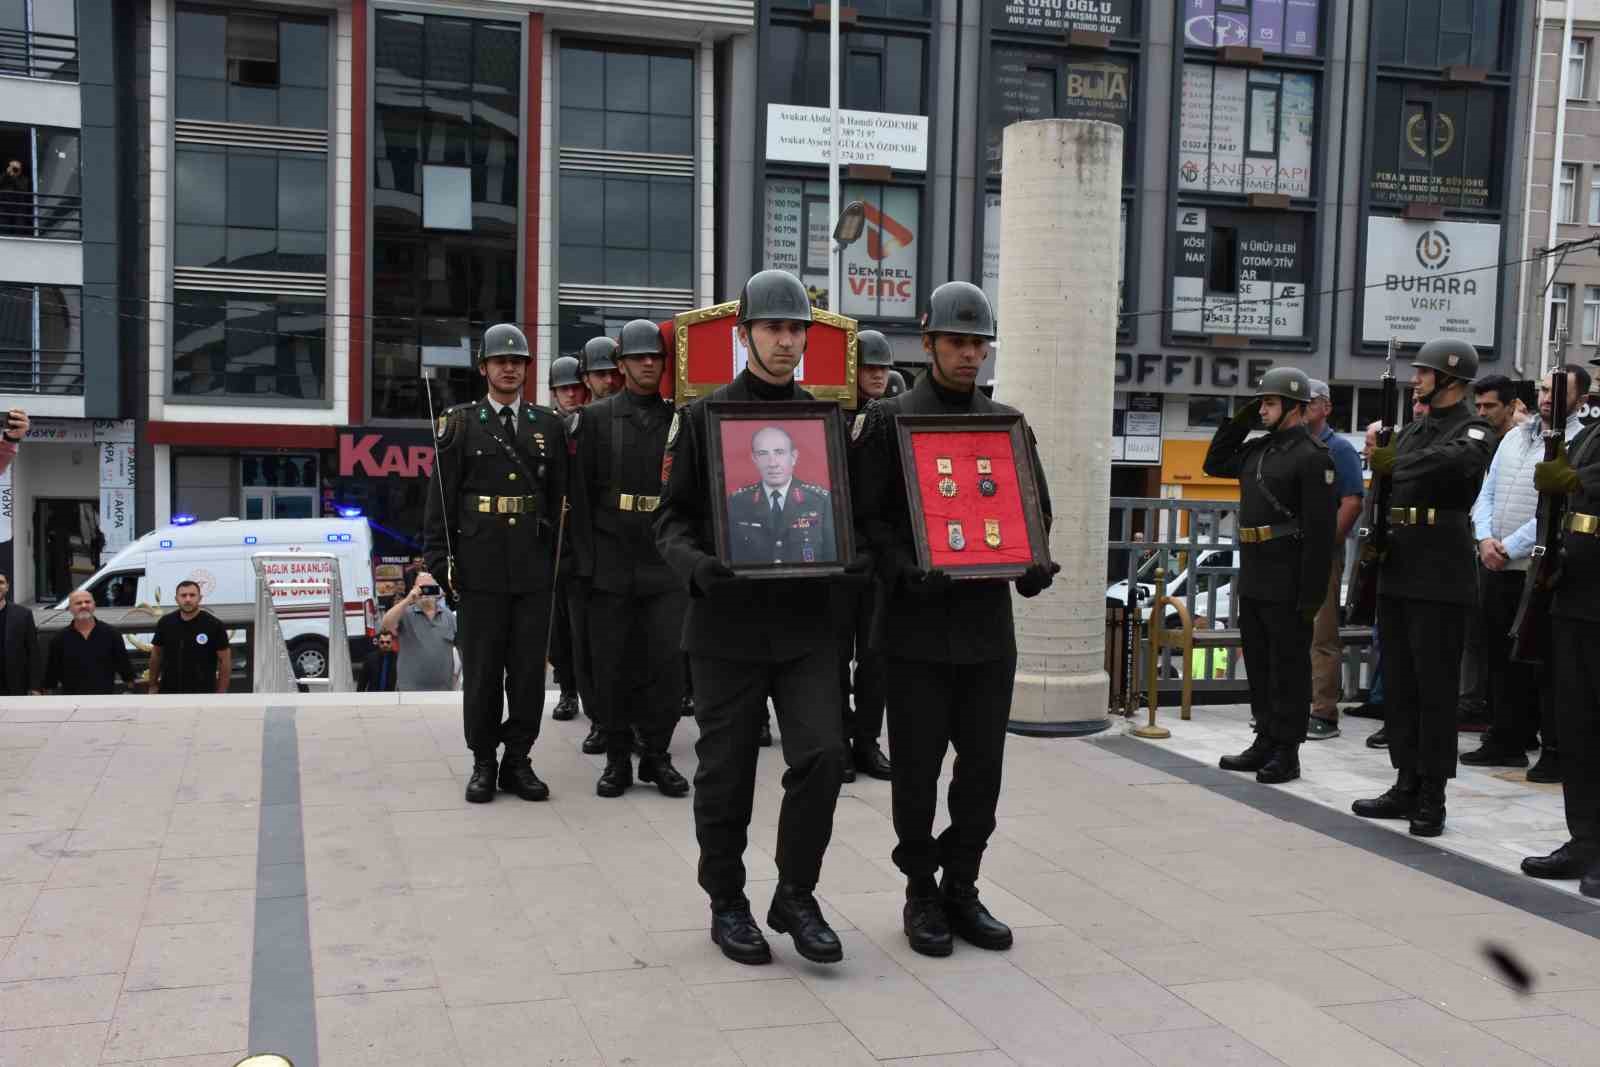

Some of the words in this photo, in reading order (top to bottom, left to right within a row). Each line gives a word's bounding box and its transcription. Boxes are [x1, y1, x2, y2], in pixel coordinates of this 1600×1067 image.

[787, 200, 800, 208] TON
[782, 240, 796, 248] TON
[1385, 273, 1477, 296] BUHARA
[1410, 297, 1451, 311] VAKFI
[1115, 353, 1273, 387] OFFICE
[2, 488, 13, 518] AKPA
[114, 499, 124, 528] AKPA
